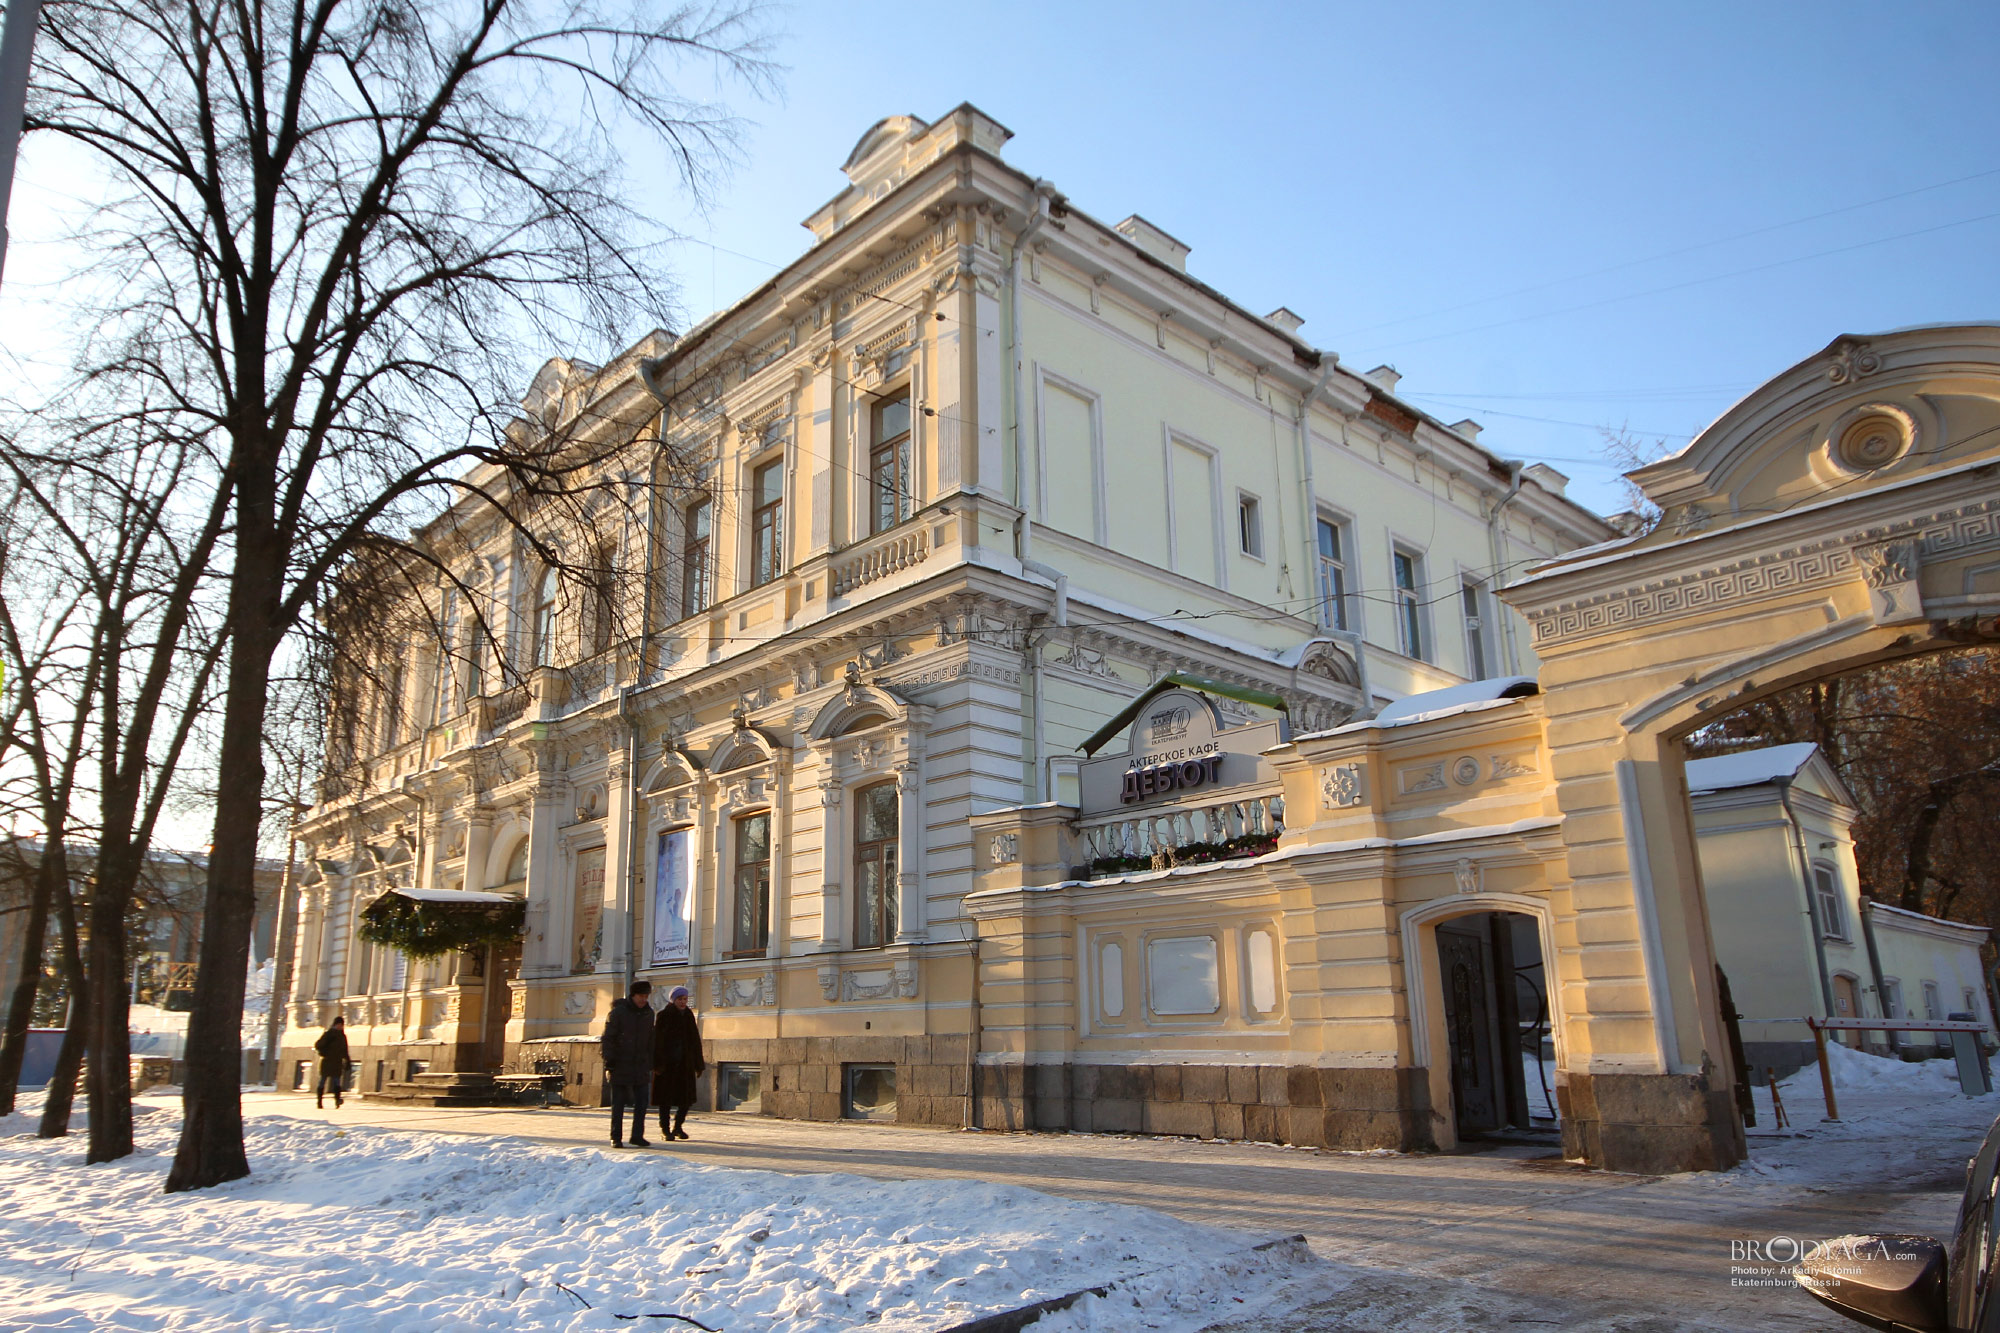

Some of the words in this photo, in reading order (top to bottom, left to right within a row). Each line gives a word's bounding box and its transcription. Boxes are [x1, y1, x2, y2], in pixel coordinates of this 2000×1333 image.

[1129, 749, 1185, 769] АКТЕРСКОЕ
[1188, 742, 1219, 757] КАФЕ
[1120, 757, 1223, 804] ДЕБЮТ
